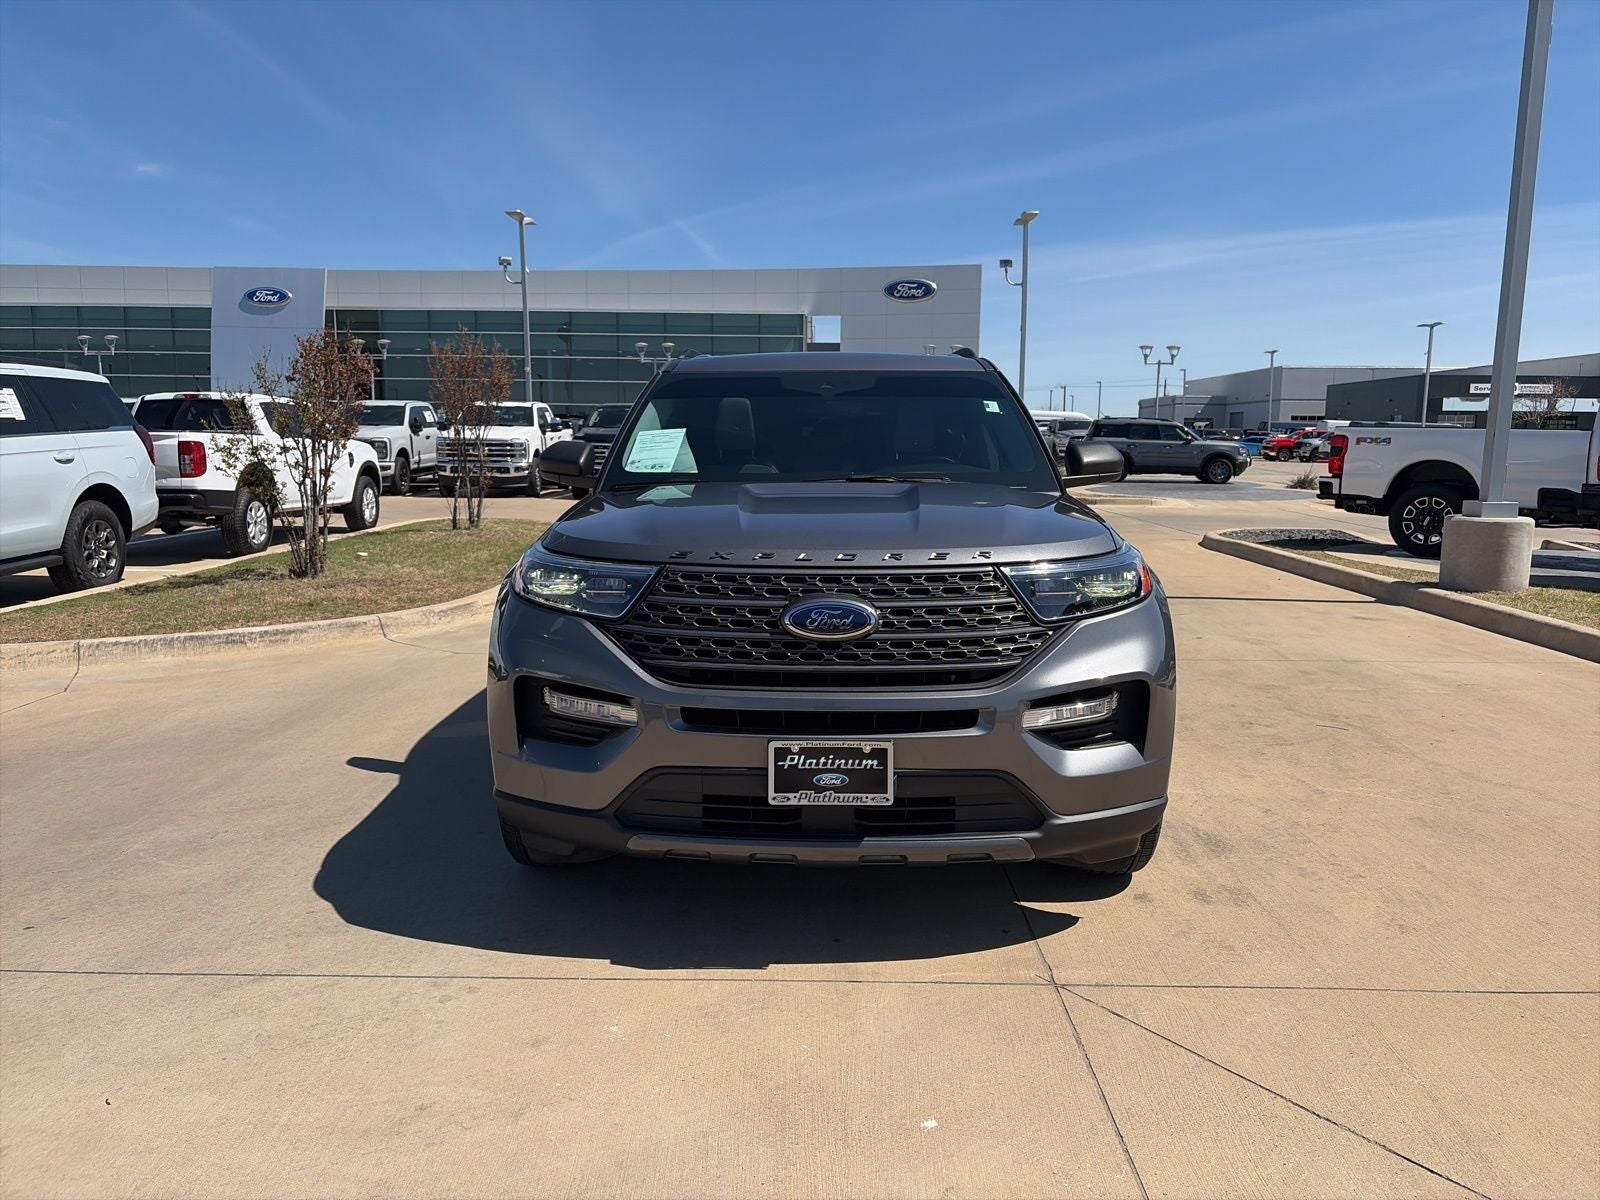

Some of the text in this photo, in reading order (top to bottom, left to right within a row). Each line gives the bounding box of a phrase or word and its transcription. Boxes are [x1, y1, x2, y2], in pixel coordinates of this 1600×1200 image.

[253, 290, 280, 302] Ford
[893, 283, 926, 297] Ford
[1355, 436, 1392, 446] FX4
[668, 550, 994, 562] EXPLORER
[805, 609, 855, 630] Ford
[777, 754, 885, 769] Platinum
[819, 775, 842, 785] Ford
[797, 791, 869, 804] Platinum
